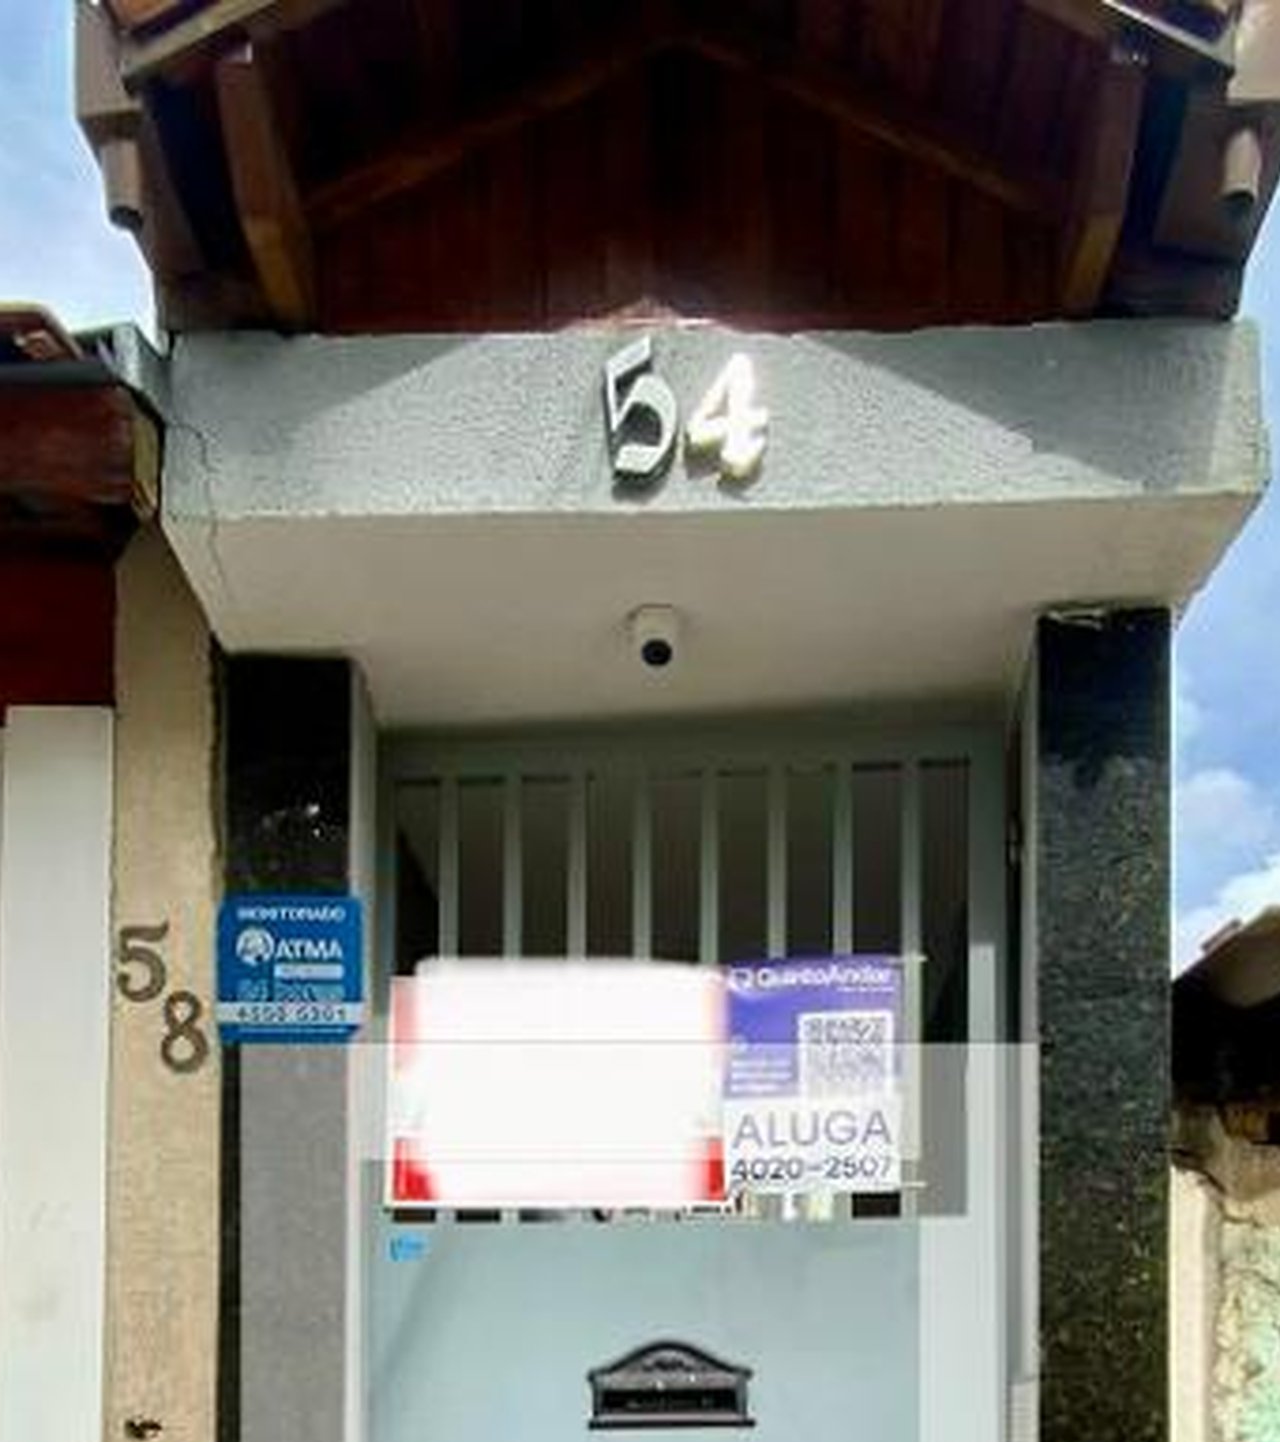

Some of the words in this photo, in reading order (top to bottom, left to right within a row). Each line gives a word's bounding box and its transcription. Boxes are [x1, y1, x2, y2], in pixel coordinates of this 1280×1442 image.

[603, 336, 769, 478] 54
[277, 939, 343, 959] ATMA
[732, 1110, 893, 1148] ALUGA
[731, 1155, 892, 1181] 4020-2507
